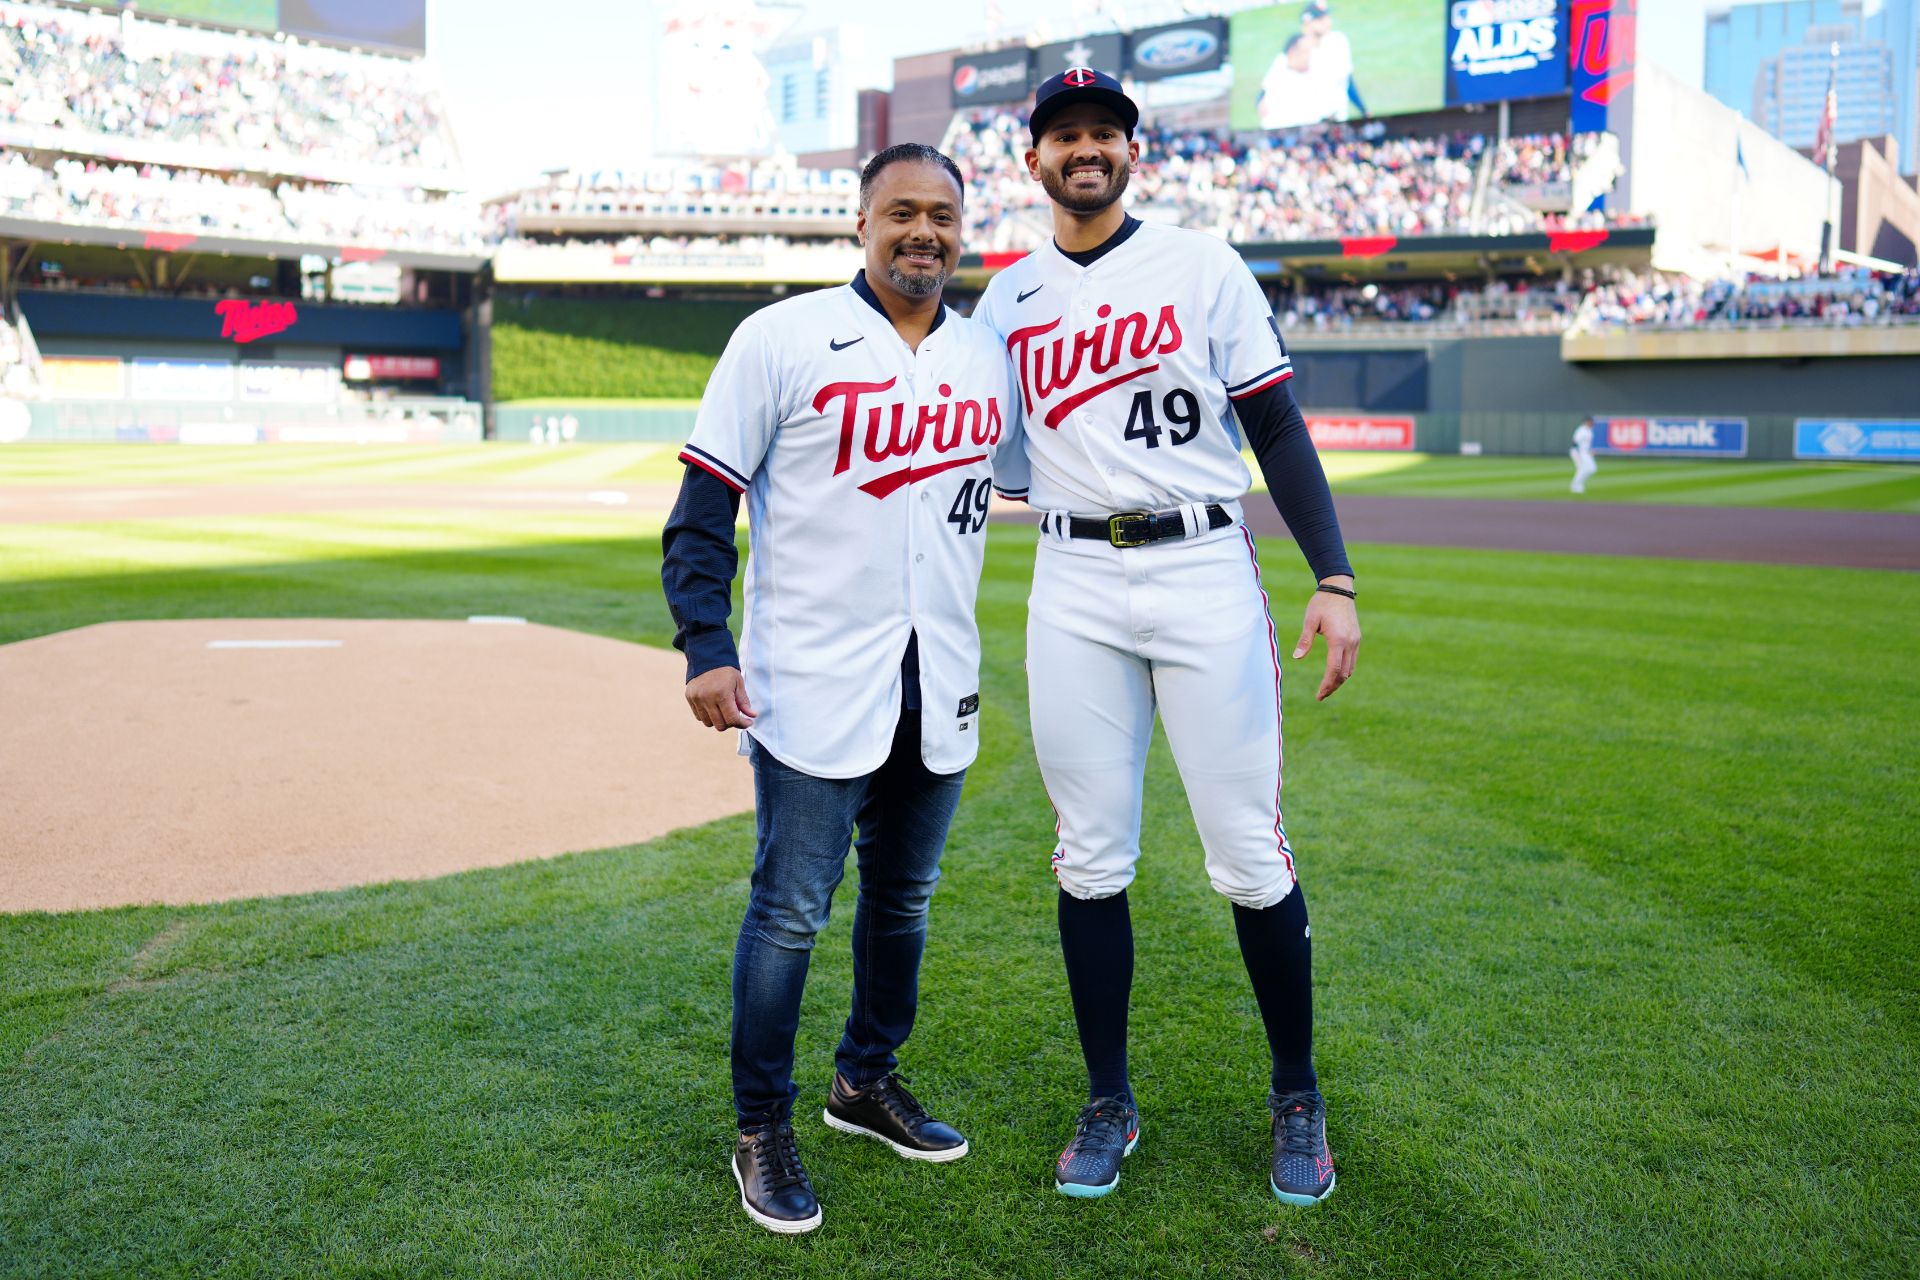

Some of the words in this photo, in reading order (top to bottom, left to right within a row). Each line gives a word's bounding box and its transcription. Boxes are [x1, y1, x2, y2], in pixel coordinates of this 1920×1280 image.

[1452, 18, 1556, 62] ALDS
[1006, 304, 1183, 424] Twins
[812, 376, 1002, 482] Twins
[1124, 388, 1201, 449] 49
[1648, 420, 1717, 447] bank
[946, 478, 993, 535] 49
